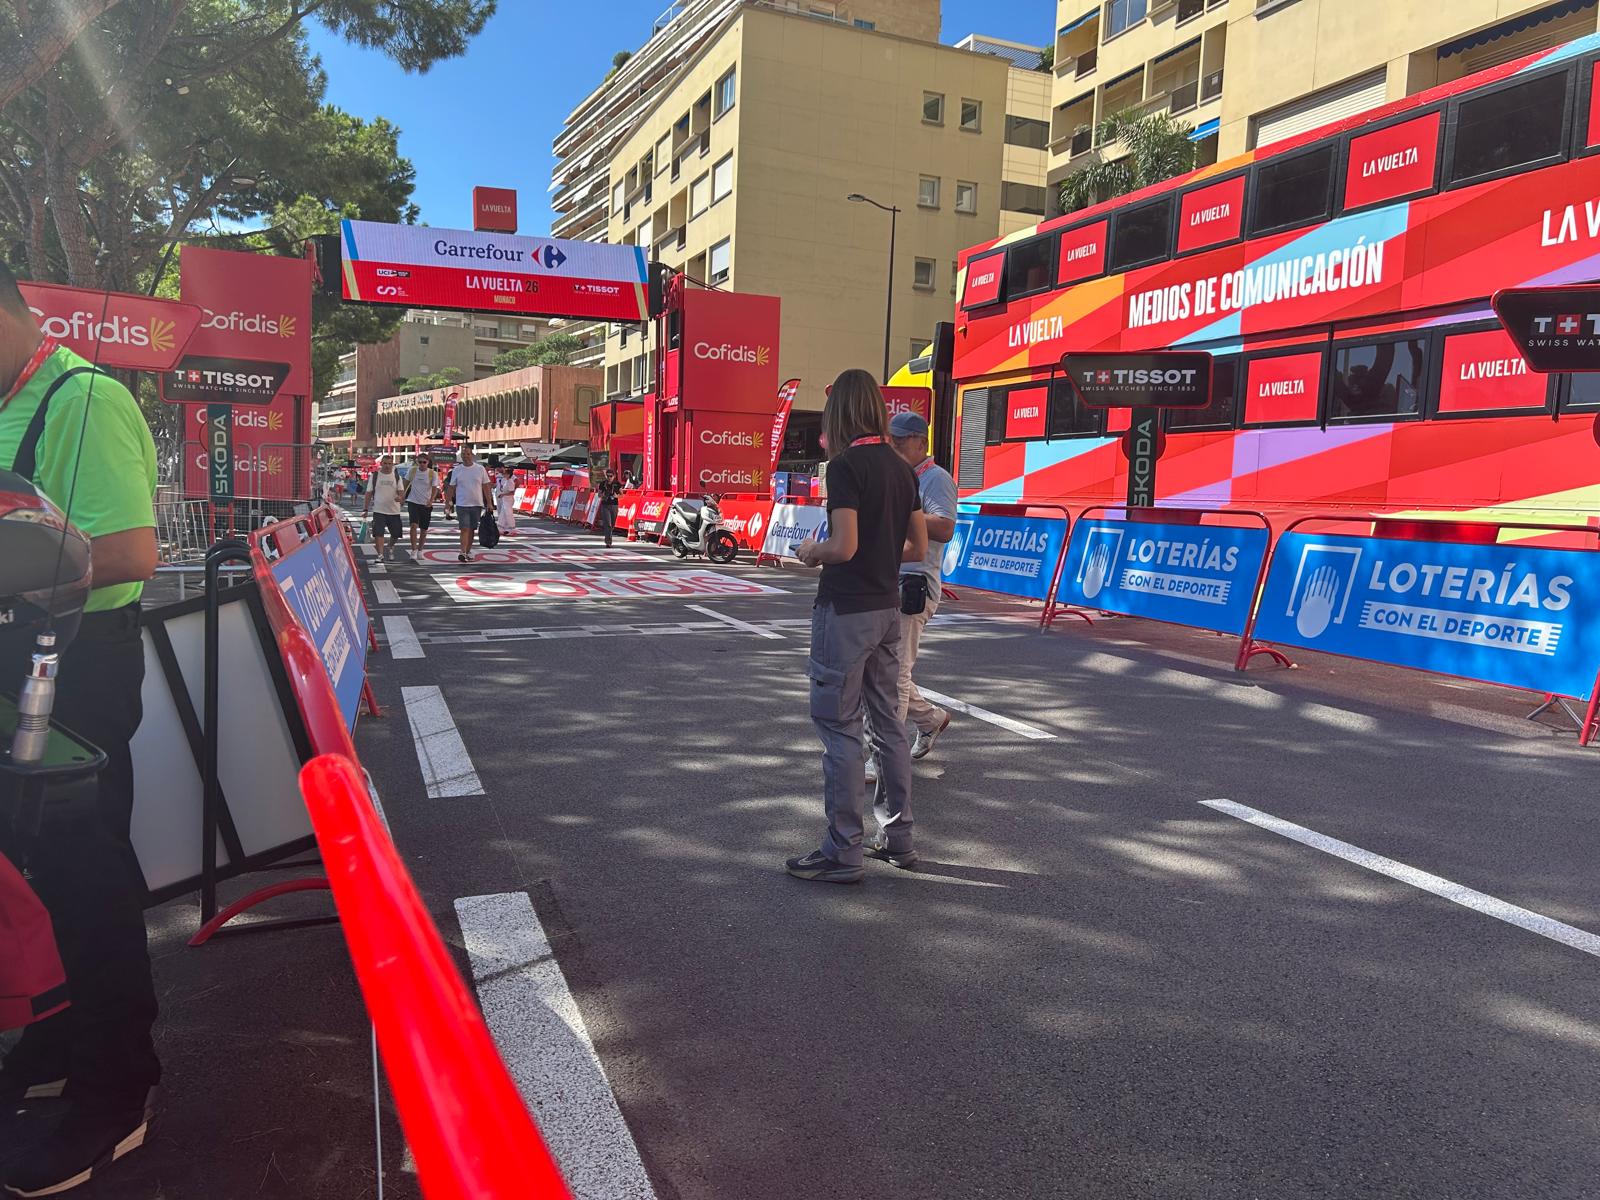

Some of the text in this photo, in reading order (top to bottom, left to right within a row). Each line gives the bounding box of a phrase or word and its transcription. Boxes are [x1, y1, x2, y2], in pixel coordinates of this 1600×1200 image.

[1362, 147, 1418, 177] LA VUELTA
[482, 204, 512, 214] LA VUELTA
[1191, 204, 1230, 226] LA VUELTA
[1542, 206, 1578, 246] LA
[434, 240, 524, 262] Carrefour
[1066, 243, 1096, 262] LA VUELTA
[466, 275, 538, 294] LA VUELTA 26
[586, 285, 620, 294] TISSOT
[972, 272, 994, 287] LA VUELTA
[1128, 236, 1384, 329] MEDIOS DE COMUNICACIÓN
[494, 294, 516, 304] MONACO
[1008, 316, 1064, 347] LA VUELTA
[694, 342, 757, 364] Cofidis
[1114, 370, 1196, 384] TISSOT
[1460, 358, 1526, 380] LA VUELTA
[203, 371, 274, 388] TISSOT
[1260, 379, 1304, 396] LA VUELTA
[196, 409, 268, 428] Cidis
[1014, 406, 1038, 418] LA VUELTA
[700, 430, 753, 446] Cofidis
[770, 411, 786, 462] LA VUELTA
[700, 469, 752, 485] Cofidis
[772, 521, 810, 540] Carrefour
[974, 523, 1048, 553] LOTERÍAS
[973, 556, 1035, 574] CON EL DEPORTE
[1127, 538, 1240, 573] LOTERÍAS
[456, 572, 763, 598] Cofidis
[1128, 574, 1221, 598] CON EL DEPORTE
[1368, 560, 1574, 612] LOTERÍAS
[1374, 608, 1542, 646] CON EL DEPORTE
